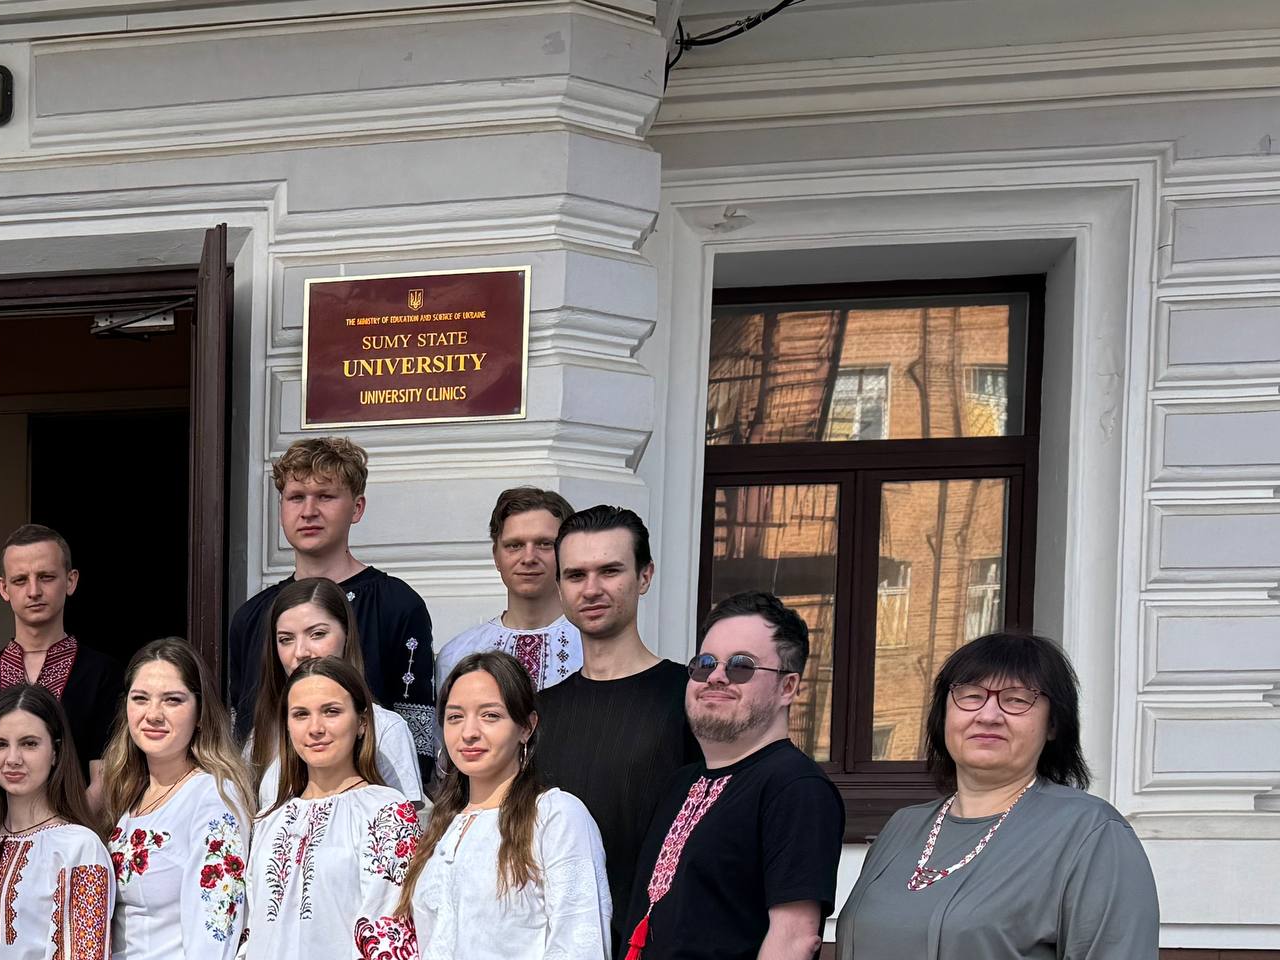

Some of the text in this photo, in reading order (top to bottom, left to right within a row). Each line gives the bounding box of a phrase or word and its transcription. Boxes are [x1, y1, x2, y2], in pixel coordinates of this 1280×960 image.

[381, 316, 389, 324] OF
[362, 331, 468, 350] SUMY STATE
[342, 352, 487, 378] UNIVERSITY
[360, 386, 467, 405] UNIVERSITY CLINICS
